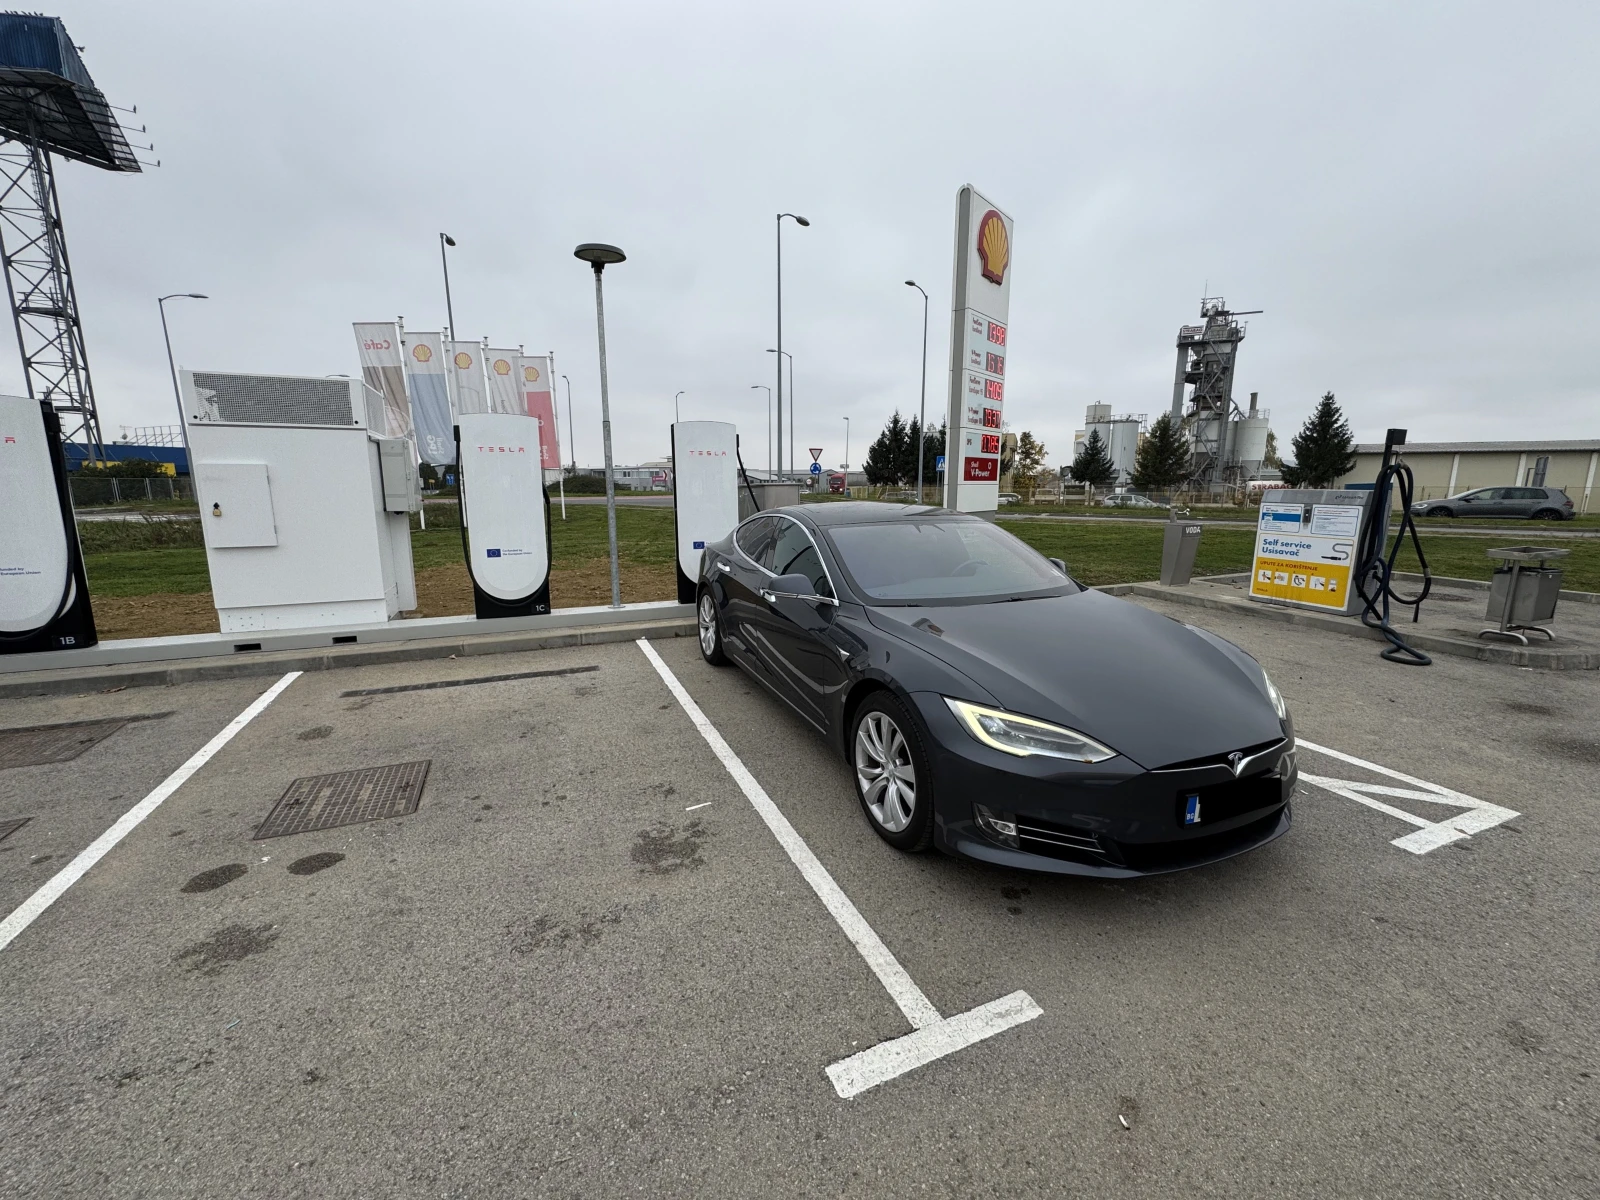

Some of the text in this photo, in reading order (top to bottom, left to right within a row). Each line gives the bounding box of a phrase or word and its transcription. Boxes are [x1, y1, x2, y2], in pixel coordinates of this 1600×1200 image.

[970, 468, 991, 477] V-Power
[1185, 526, 1201, 534] VODA
[1263, 538, 1312, 549] Self service
[1262, 546, 1300, 556] Usisavač
[535, 604, 545, 612] 1C
[60, 636, 76, 645] 1B
